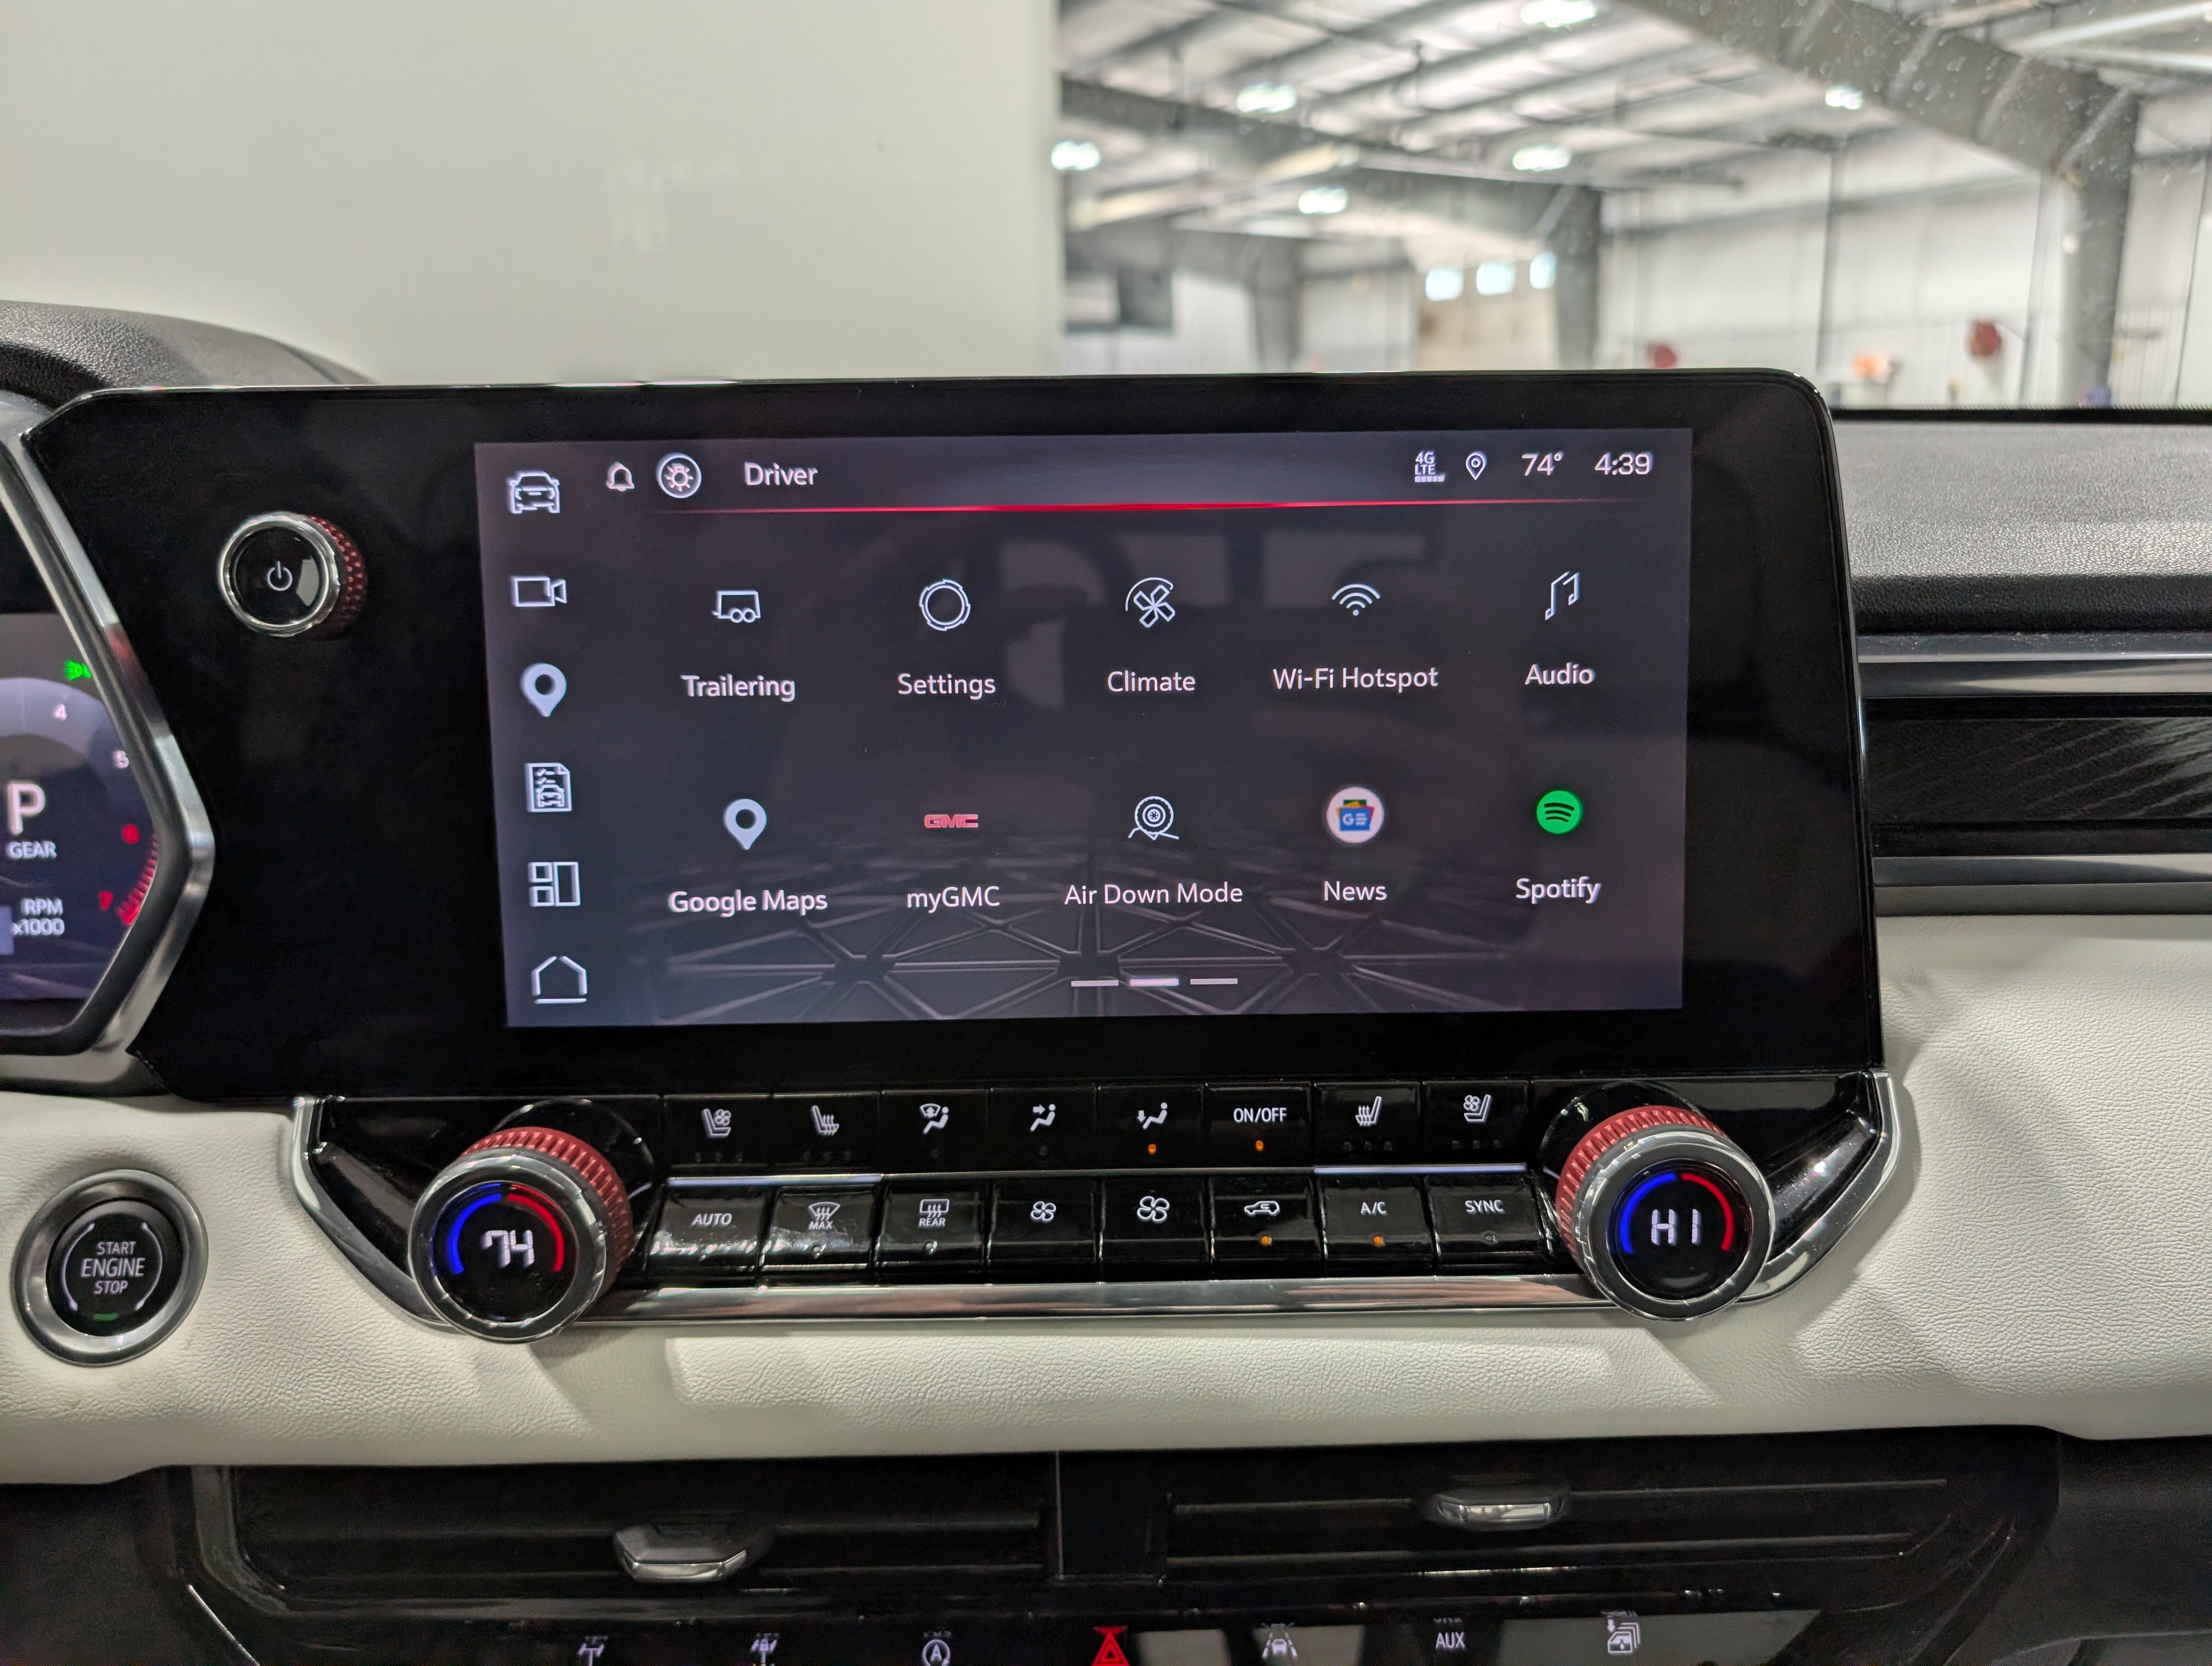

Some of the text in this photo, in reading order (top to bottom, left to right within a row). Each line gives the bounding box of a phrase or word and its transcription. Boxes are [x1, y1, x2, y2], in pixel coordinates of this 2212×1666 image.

[1415, 451, 1435, 464] 4G
[1522, 451, 1564, 476] 74°
[1594, 451, 1654, 476] 4:39
[744, 462, 818, 487] Driver
[1414, 464, 1435, 475] LTE
[1107, 670, 1195, 693] Climate
[1273, 667, 1439, 693] Wi-Fi Hotspot
[1525, 662, 1596, 685] Audio
[681, 674, 796, 702] Trailering
[898, 673, 996, 700] Settings
[54, 703, 67, 720] 4
[7, 781, 46, 834] P
[924, 814, 978, 828] GMC
[7, 841, 57, 859] GEAR
[907, 886, 1000, 913] myGMC
[1064, 882, 1243, 905] Air Down Mode
[1323, 881, 1387, 901] News
[1516, 876, 1601, 904] Spotify
[21, 899, 63, 915] RPM
[668, 890, 827, 917] Google Maps
[12, 918, 65, 935] x1000
[1233, 1107, 1287, 1123] ON/OFF
[1360, 1201, 1387, 1215] A/C
[1465, 1200, 1506, 1214] SYNC
[691, 1213, 732, 1227] AUTO
[809, 1221, 833, 1230] MAX
[918, 1217, 946, 1227] REAR
[1651, 1208, 1702, 1246] HI
[97, 1241, 137, 1255] START
[480, 1229, 535, 1268] 74
[81, 1258, 145, 1278] ENGINE
[94, 1280, 128, 1295] STOP
[1435, 1632, 1466, 1651] AUX
